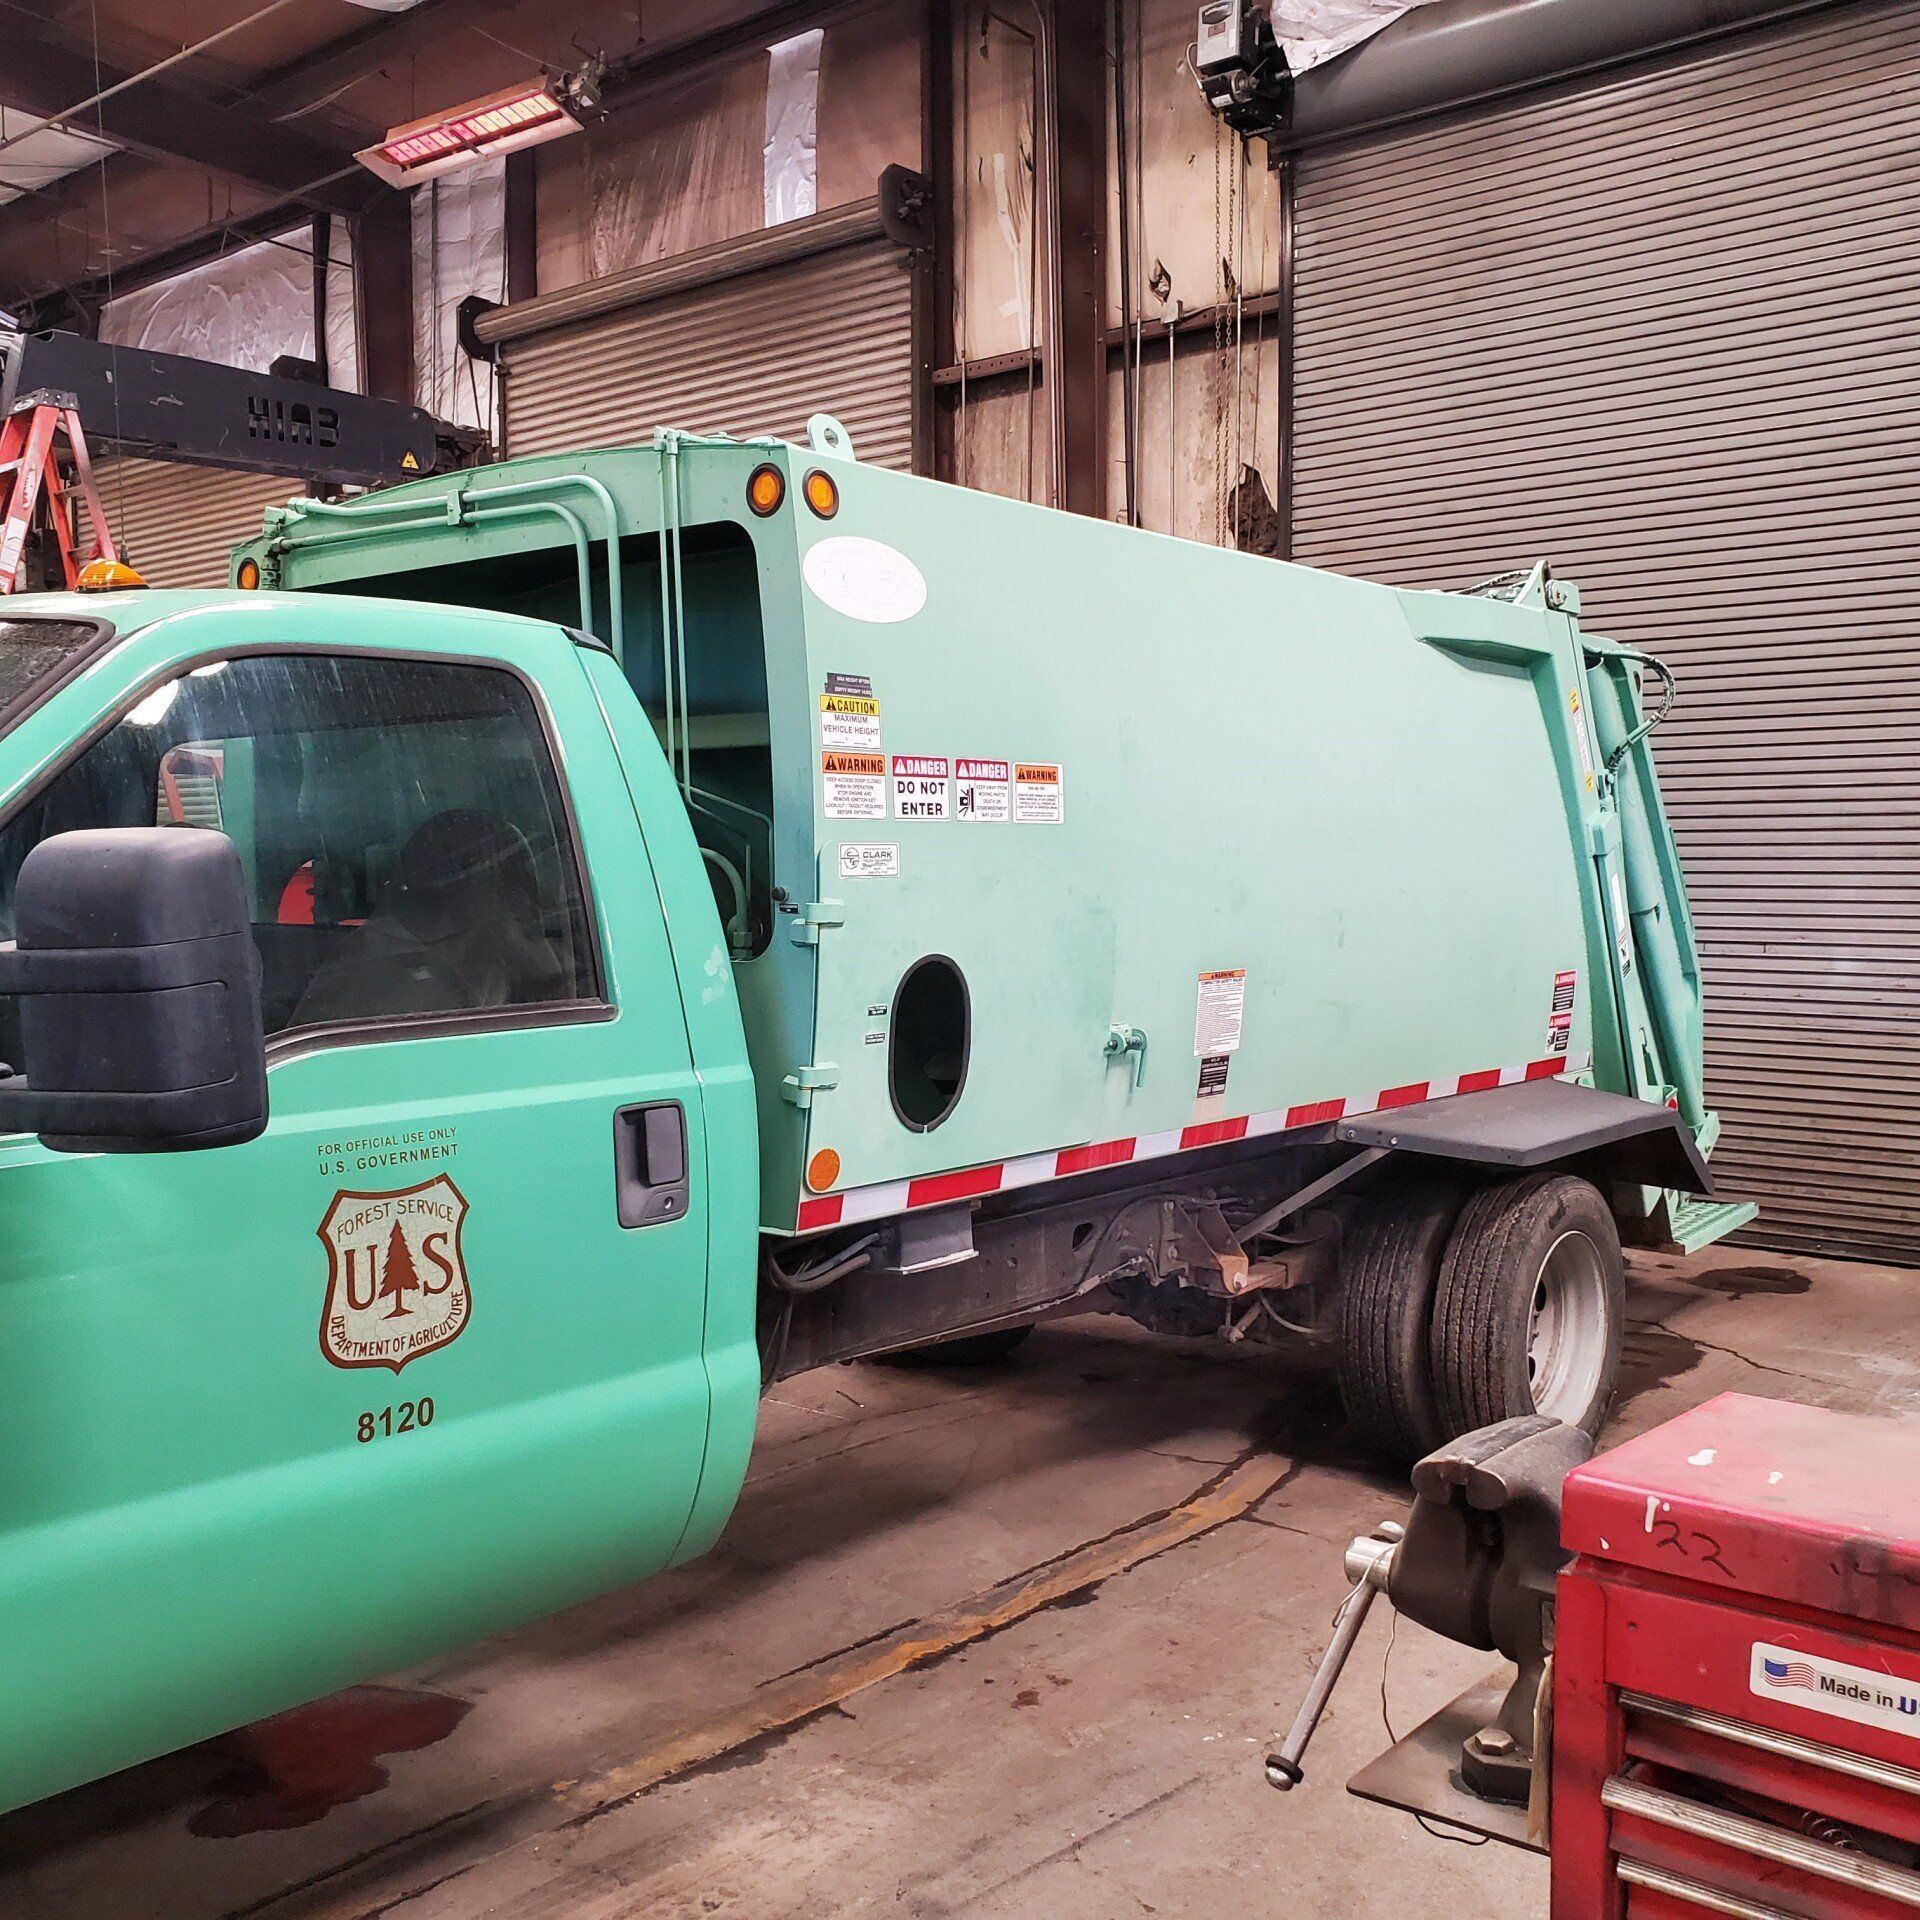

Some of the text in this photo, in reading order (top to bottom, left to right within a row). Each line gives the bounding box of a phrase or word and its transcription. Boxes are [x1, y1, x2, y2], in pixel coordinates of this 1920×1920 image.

[248, 396, 340, 448] HIAB
[837, 700, 875, 714] CAUTION
[834, 714, 868, 723] MAXIMUM
[823, 724, 878, 735] VEHICLE HEIGHT
[837, 758, 883, 772] WARNING
[906, 759, 947, 776] DANGER
[969, 762, 1007, 779] DANGER
[1026, 770, 1057, 781] WARNING
[897, 781, 945, 795] DO NOT
[902, 802, 943, 815] ENTER
[317, 1127, 457, 1156] FOR OFFICIAL USE ONLY
[319, 1144, 458, 1175] U.S. GOVERNMENT
[337, 1200, 454, 1243] FOREST SERVICE
[331, 1289, 463, 1358] DEPARTMENT OF AGRICULTURE
[357, 1397, 434, 1443] 8120
[1820, 1675, 1870, 1701] Made
[1876, 1691, 1893, 1708] in
